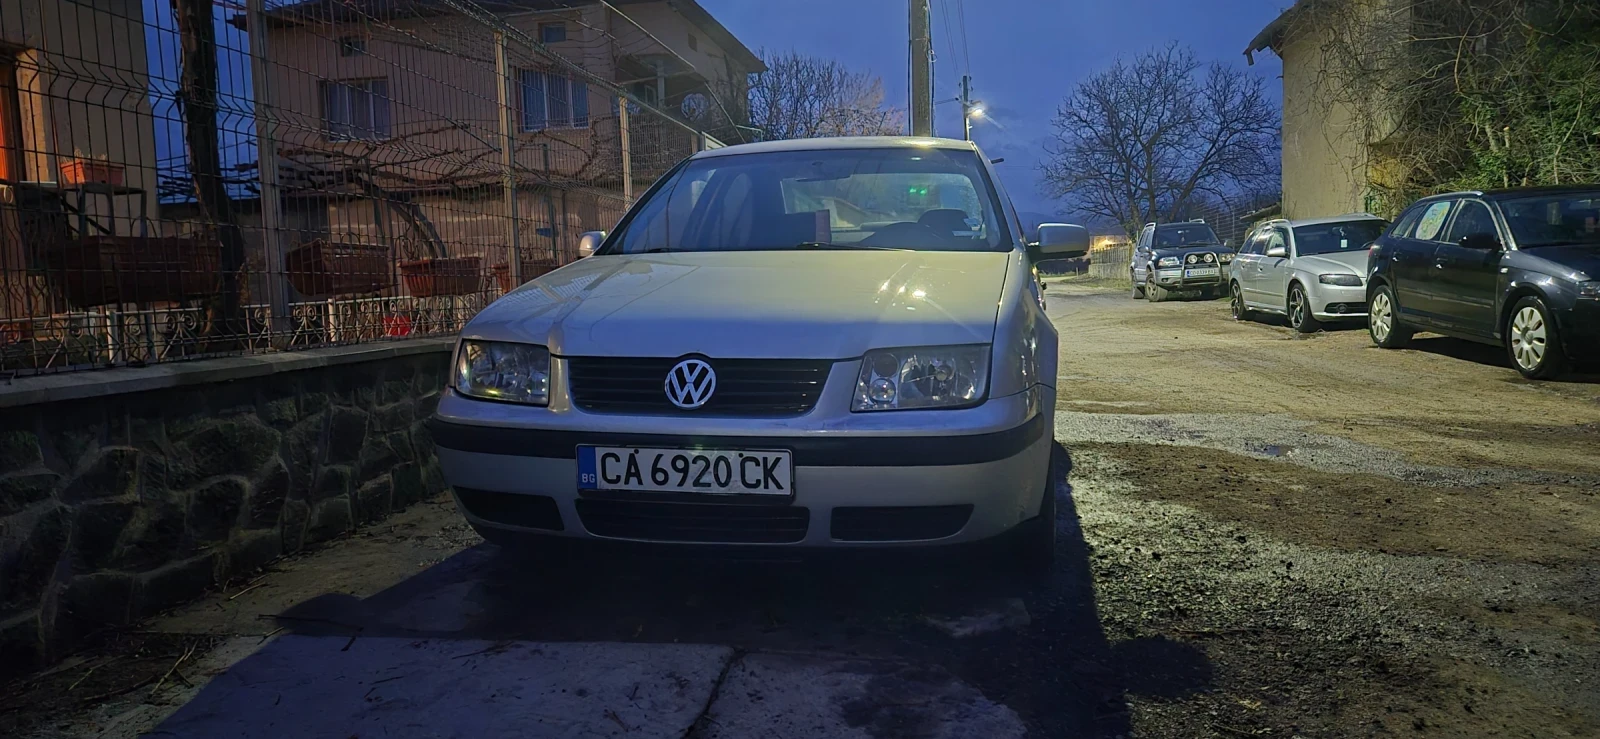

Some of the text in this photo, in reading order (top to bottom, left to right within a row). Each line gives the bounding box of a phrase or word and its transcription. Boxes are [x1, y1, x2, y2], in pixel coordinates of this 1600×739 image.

[666, 360, 715, 407] VW
[582, 473, 596, 484] BG
[601, 452, 784, 490] CA 6920 CK
